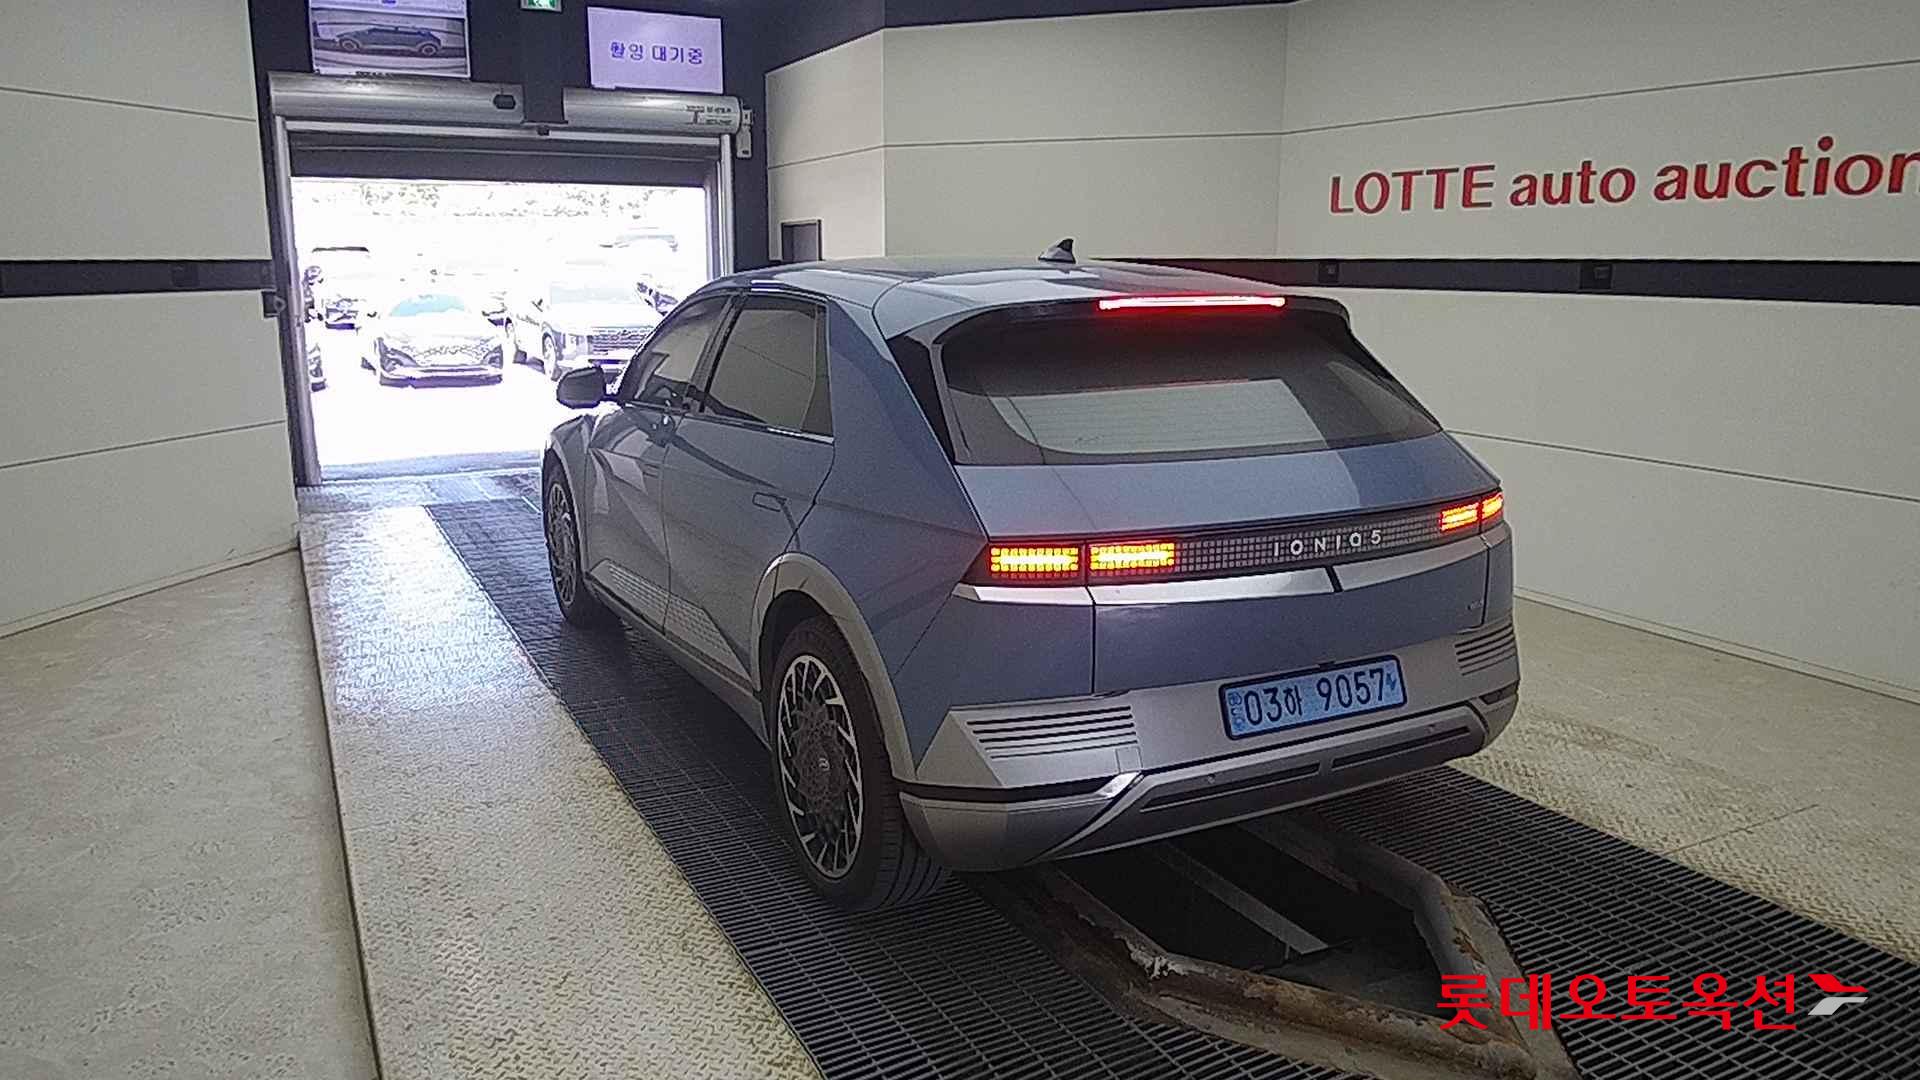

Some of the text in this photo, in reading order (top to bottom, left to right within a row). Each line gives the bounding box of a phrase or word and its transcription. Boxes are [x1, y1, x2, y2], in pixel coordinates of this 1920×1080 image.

[651, 44, 703, 65] 대기중
[1330, 135, 1920, 214] LOTTE auto auction
[1243, 685, 1304, 726] 03하
[1316, 667, 1385, 712] 9057
